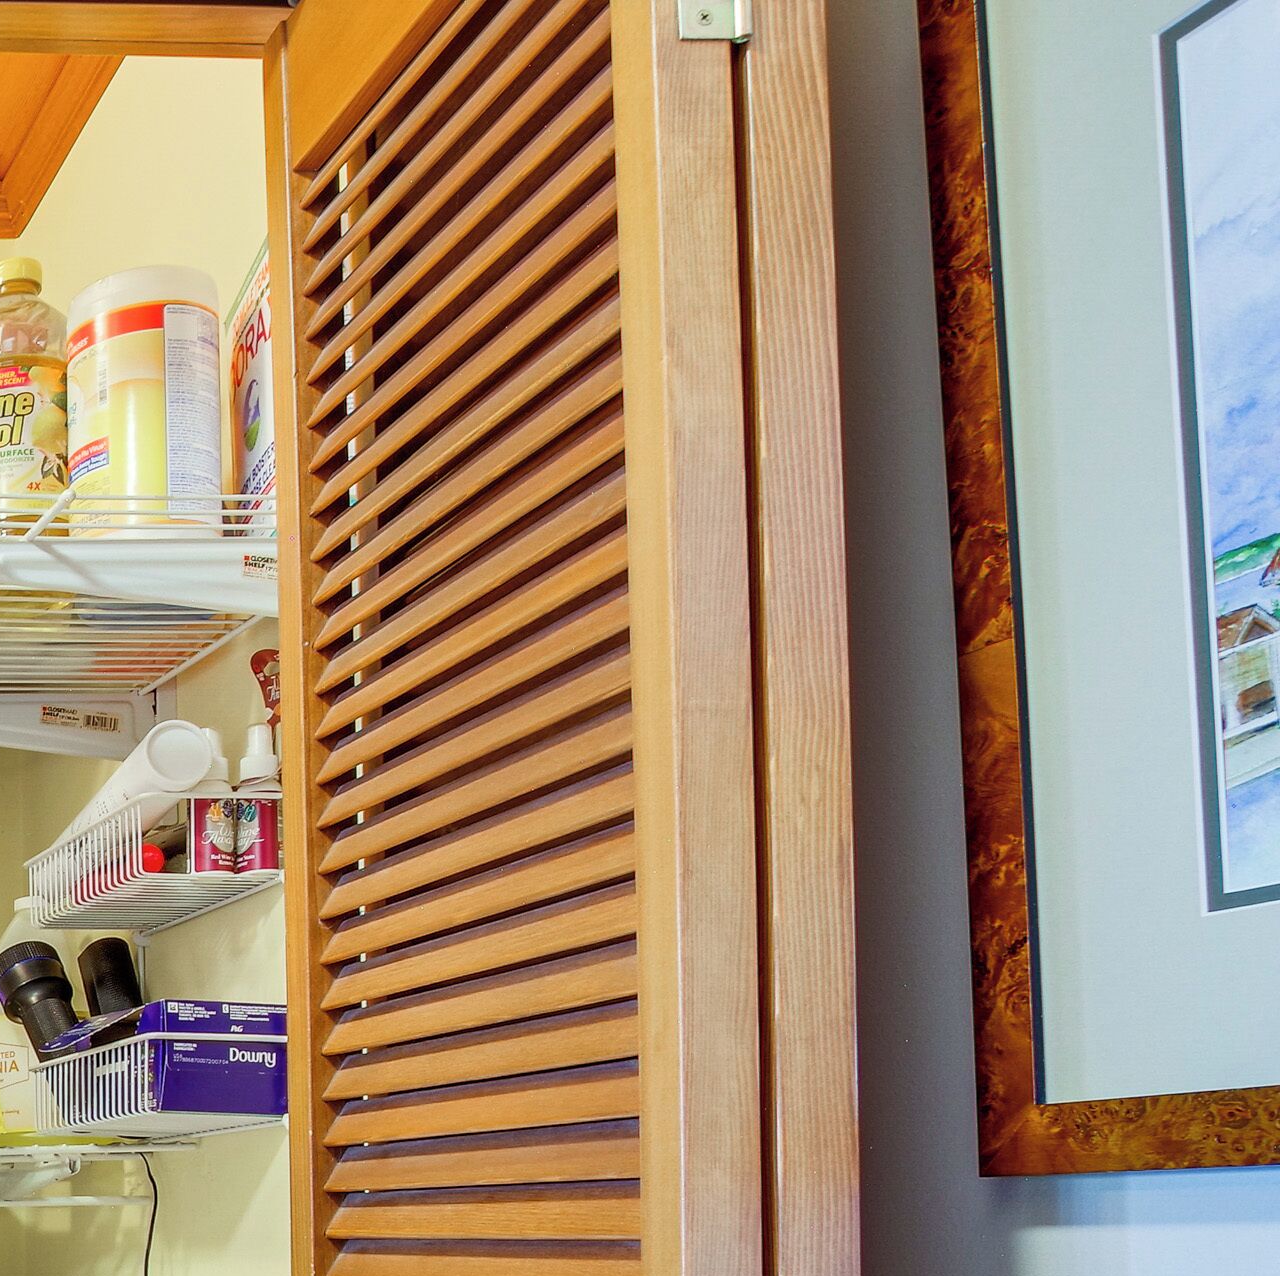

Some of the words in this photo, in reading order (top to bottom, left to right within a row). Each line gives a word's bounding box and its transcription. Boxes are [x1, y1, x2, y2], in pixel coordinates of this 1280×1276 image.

[230, 305, 273, 388] ORA
[5, 377, 26, 386] SCENT
[27, 482, 41, 491] 4X
[244, 561, 265, 569] SHELF
[229, 1047, 276, 1068] Downy
